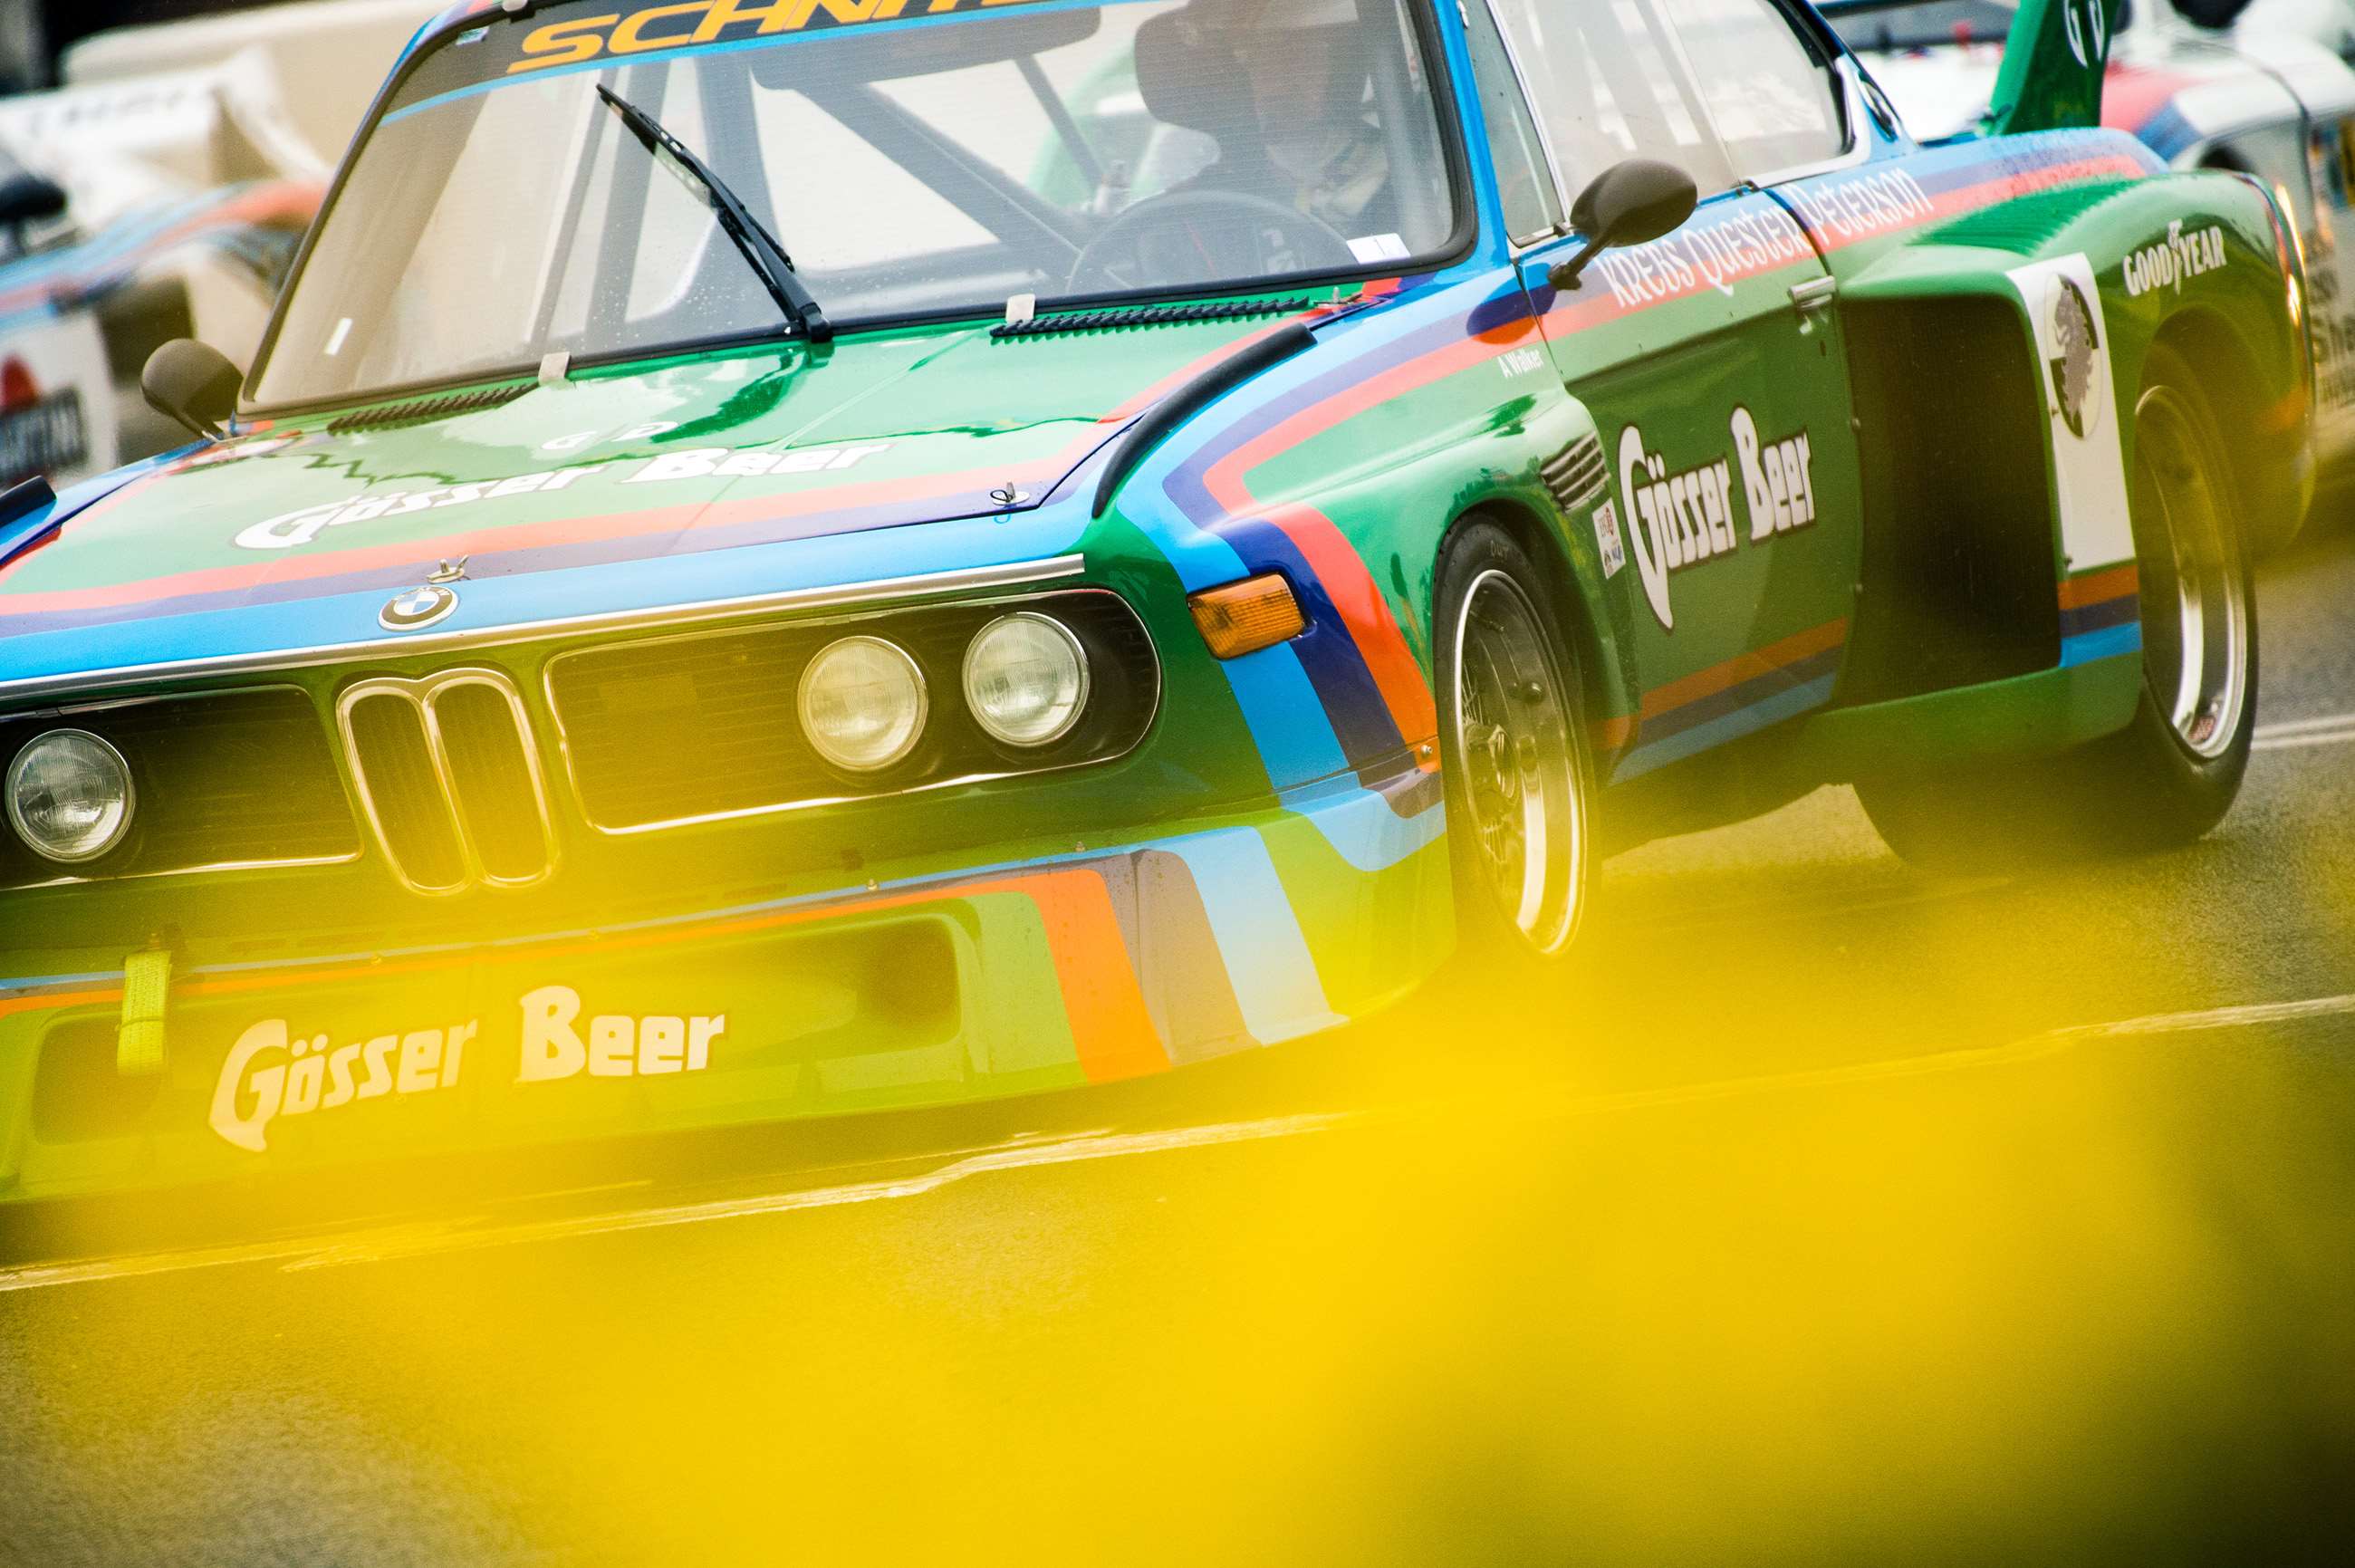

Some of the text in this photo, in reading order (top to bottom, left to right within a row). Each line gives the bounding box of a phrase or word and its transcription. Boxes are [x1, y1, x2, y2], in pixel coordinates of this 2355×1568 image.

[233, 443, 898, 549] Gösser Beer
[1619, 406, 1815, 630] Gösser Beer
[207, 984, 726, 1152] Gösser Beer
